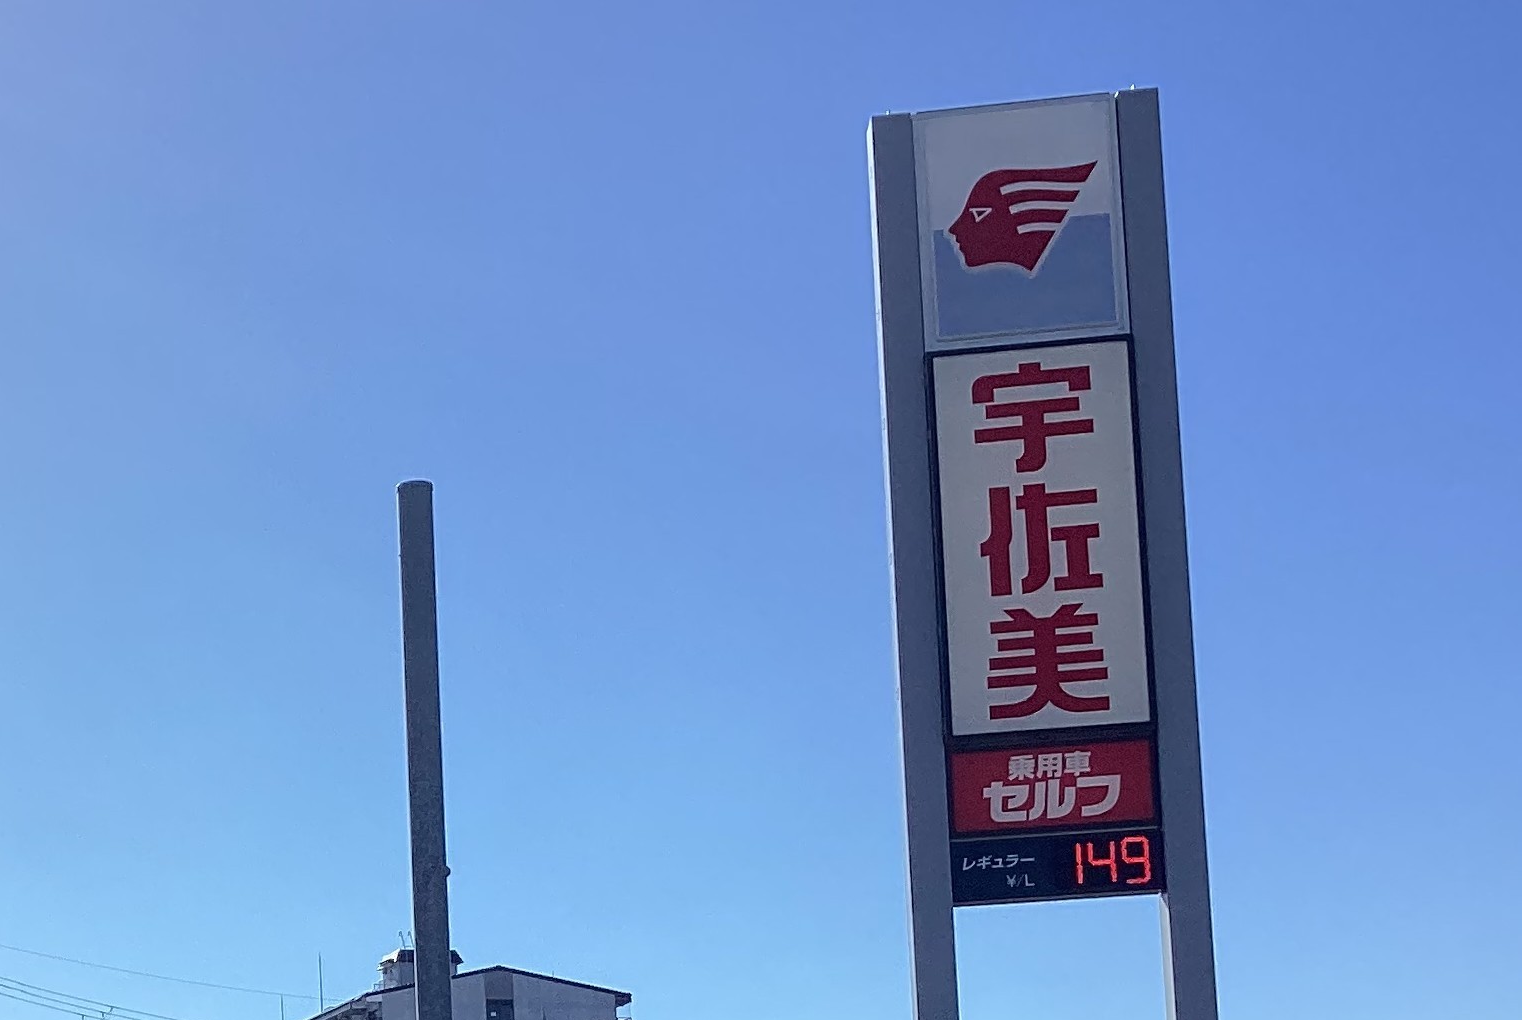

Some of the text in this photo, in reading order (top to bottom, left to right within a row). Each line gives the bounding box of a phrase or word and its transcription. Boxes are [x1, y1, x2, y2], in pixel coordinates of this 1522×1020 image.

[971, 362, 1110, 719] 宇佐美
[1008, 751, 1091, 780] 乗用車
[983, 774, 1122, 823] セルフ
[962, 854, 1036, 871] レギュラー
[1073, 835, 1152, 885] 149
